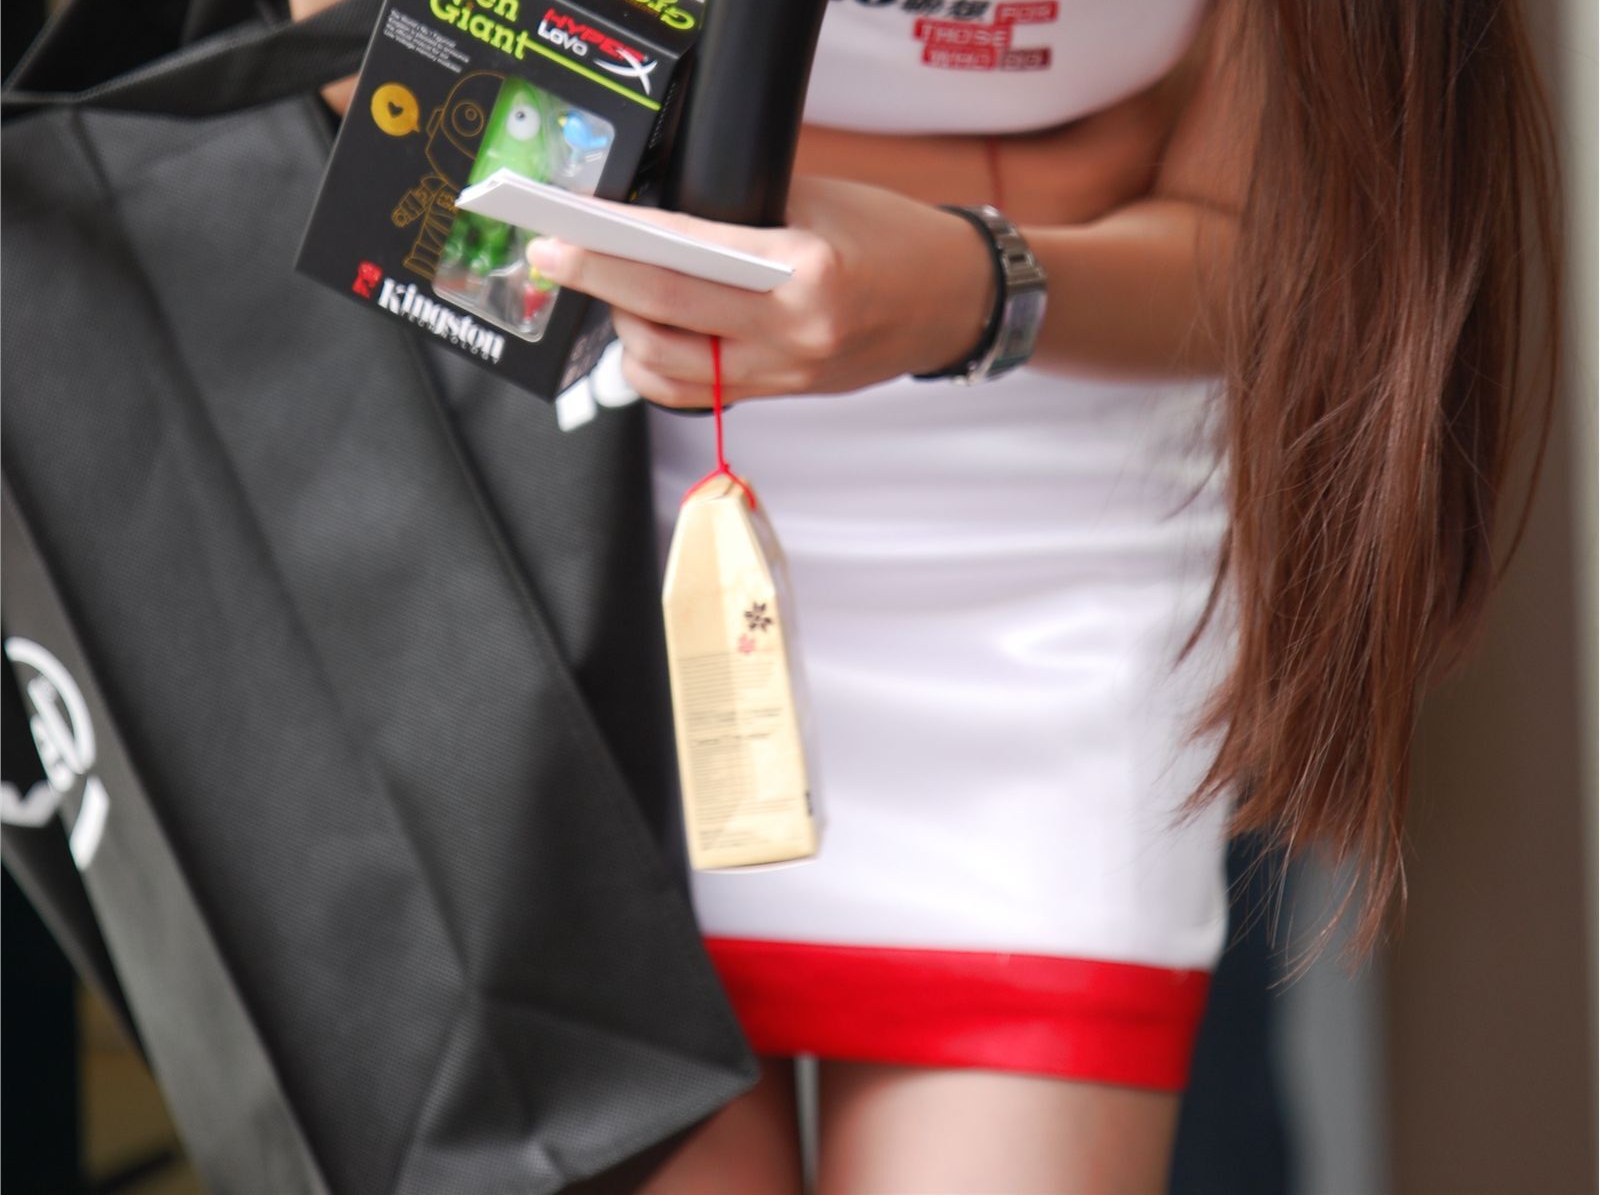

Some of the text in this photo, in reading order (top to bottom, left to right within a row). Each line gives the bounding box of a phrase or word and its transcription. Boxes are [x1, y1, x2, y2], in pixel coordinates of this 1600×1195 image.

[1000, 5, 1050, 21] FOR
[920, 22, 1008, 46] THOSE
[378, 276, 506, 360] Kingston
